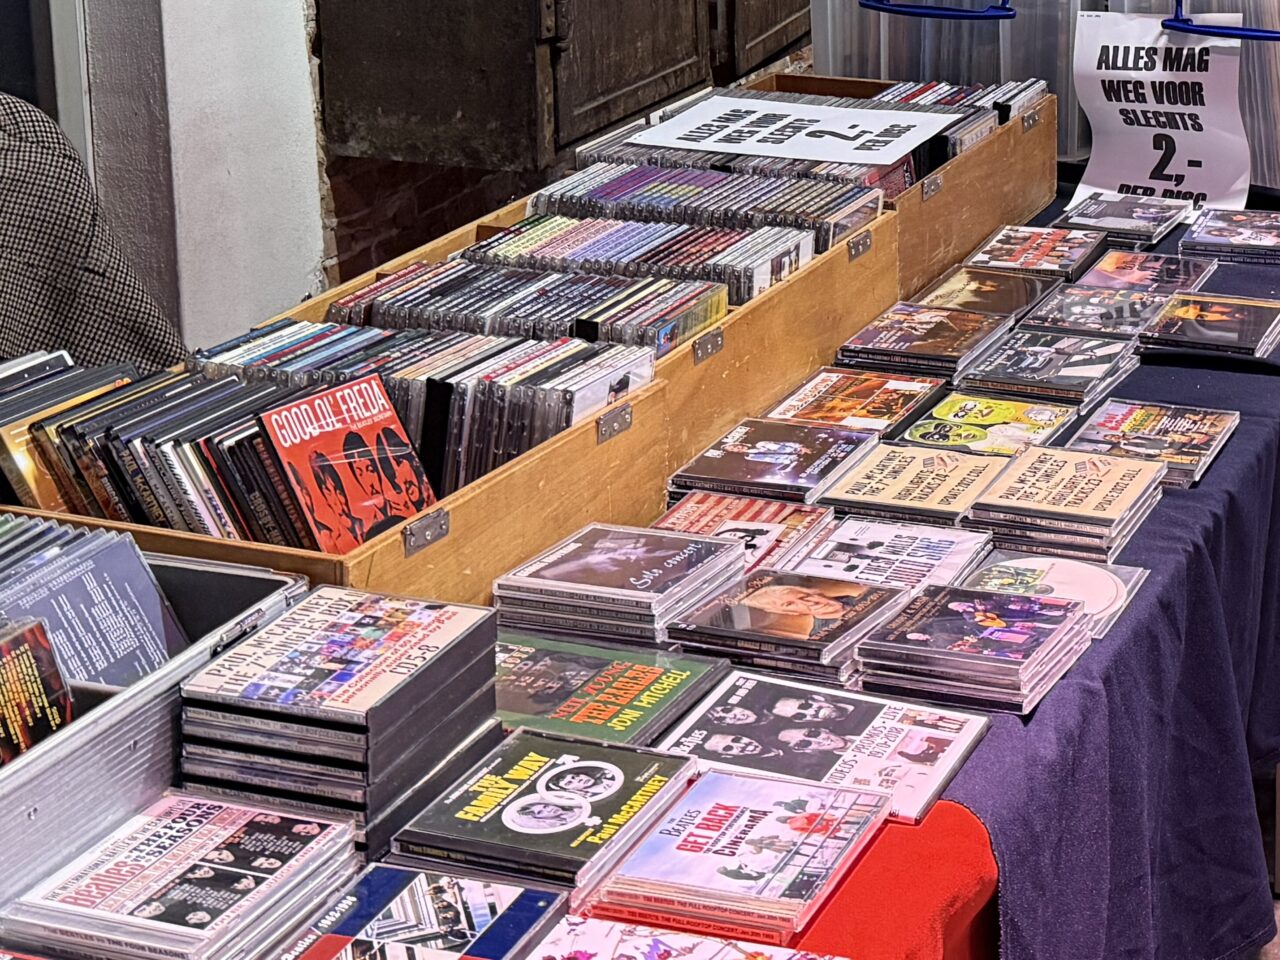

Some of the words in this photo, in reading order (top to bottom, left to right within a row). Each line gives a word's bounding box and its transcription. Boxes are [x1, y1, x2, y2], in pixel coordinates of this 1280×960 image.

[1096, 45, 1158, 72] ALLES
[1162, 47, 1211, 73] MAG
[1100, 79, 1148, 104] WEG
[1151, 80, 1206, 107] VOOR
[677, 123, 729, 143] ALLES
[712, 108, 758, 127] MAG
[713, 125, 761, 145] WEG
[756, 117, 821, 145] SLECHTS
[1119, 108, 1204, 132] SLECHTS
[853, 137, 895, 152] PER
[1149, 133, 1203, 187] 2,-
[271, 403, 322, 448] GOOD
[314, 394, 343, 430] OL'
[336, 379, 390, 424] FREDA
[118, 449, 138, 474] PAUL
[131, 474, 165, 523] McCARTNEY
[138, 461, 153, 482] PAUL
[159, 449, 191, 496] GOLDEN
[844, 480, 871, 495] PAUL
[860, 450, 904, 480] McCARTNEY
[862, 485, 886, 496] THE
[880, 455, 917, 479] SINGLES
[998, 485, 1024, 499] PAUL
[1013, 452, 1056, 484] McCARTNEY
[1016, 489, 1039, 501] THE
[1034, 459, 1069, 483] SINGLES
[100, 476, 119, 503] RINGO
[664, 543, 702, 568] concert
[876, 534, 923, 556] WALLS
[903, 537, 958, 560] SING
[855, 554, 900, 576] THESE
[873, 558, 938, 589] COULD
[206, 649, 259, 677] PAUL
[246, 594, 336, 648] McCARTNEY
[216, 670, 259, 691] THE
[262, 617, 330, 657] SINGLES
[318, 596, 359, 616] BOX
[338, 667, 391, 704] personally
[383, 632, 434, 667] supervised
[427, 624, 445, 632] by
[436, 610, 460, 624] Paul
[388, 660, 421, 675] CD
[405, 643, 441, 662] 5-8
[327, 689, 352, 703] The
[345, 655, 393, 688] Collection
[386, 647, 402, 655] of
[568, 702, 621, 725] THE
[595, 664, 669, 704] EAGLES
[602, 709, 646, 730] JONI
[630, 669, 694, 707] MITCHELL
[825, 757, 859, 785] VIDEOS
[851, 724, 888, 754] PROMOS
[878, 704, 905, 721] LIVE
[867, 726, 906, 758] 1970-2018
[454, 778, 523, 820] FAMILY
[501, 751, 554, 780] WAY
[467, 773, 503, 793] THE
[583, 822, 620, 843] Paul
[604, 774, 672, 823] McCARTNEY
[658, 807, 701, 837] BEATLES
[694, 802, 740, 831] BACK
[124, 834, 143, 842] OF
[128, 828, 172, 854] THE
[160, 802, 209, 830] FOUR
[132, 826, 154, 836] THE
[142, 804, 227, 857] SEASONS
[675, 830, 716, 853] GET
[711, 807, 772, 857] CINERAMA
[103, 840, 135, 857] BATTLE
[56, 856, 113, 891] INTERNATIONAL
[56, 859, 146, 907] Beatles
[207, 912, 232, 934] YOU
[293, 845, 315, 863] AND
[41, 890, 65, 901] THE
[124, 942, 142, 951] FOUR
[144, 946, 184, 959] SEASONS
